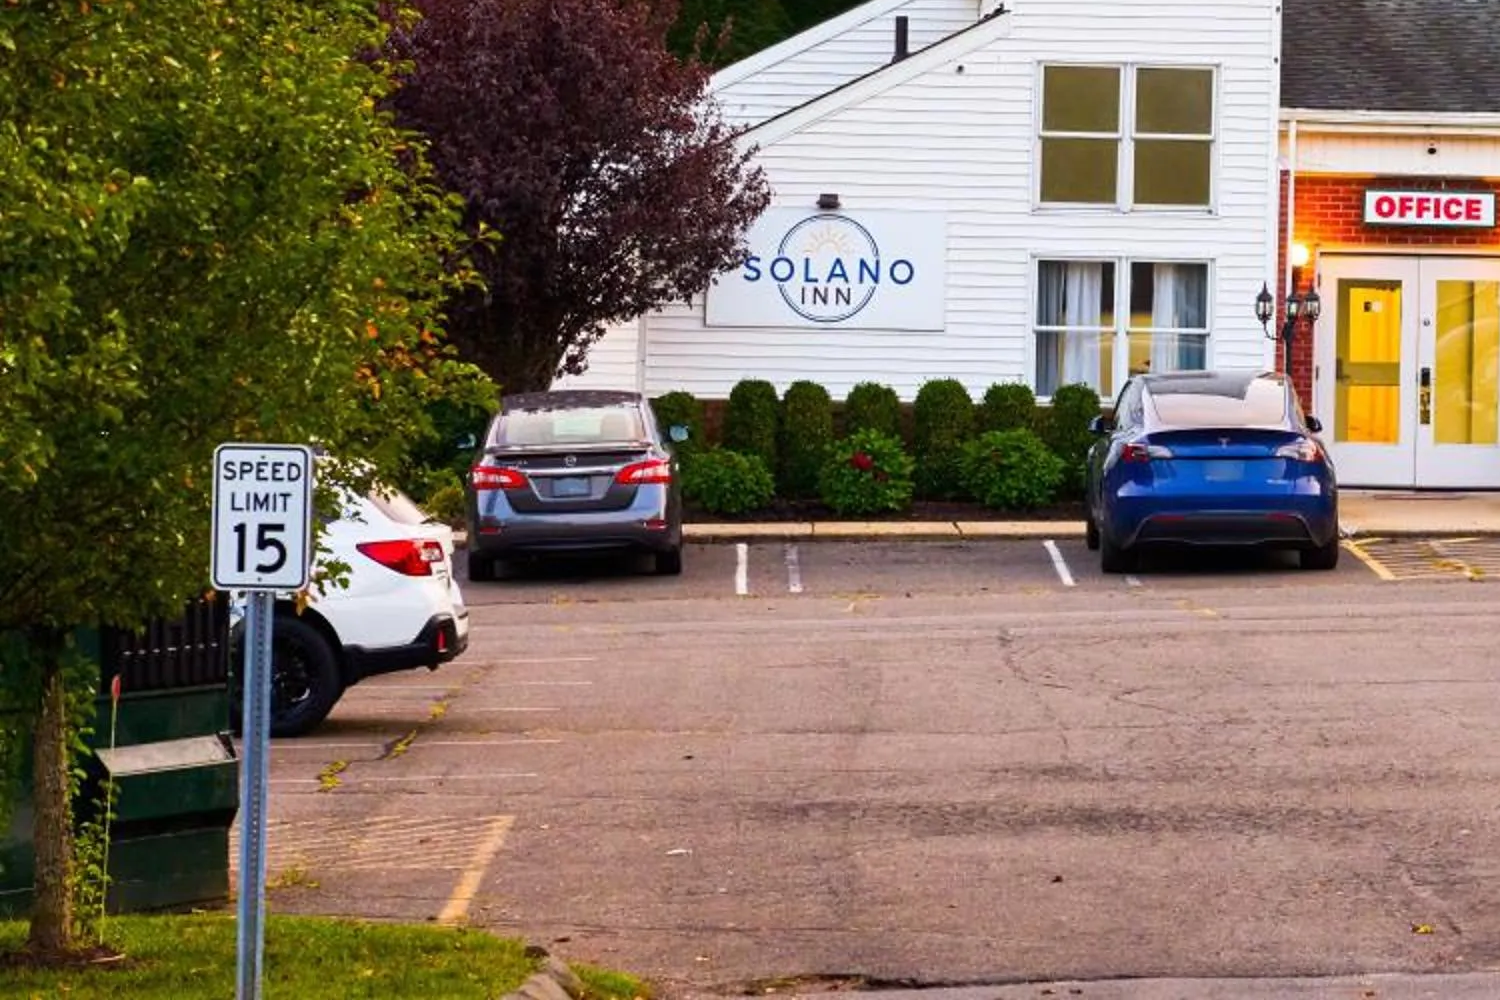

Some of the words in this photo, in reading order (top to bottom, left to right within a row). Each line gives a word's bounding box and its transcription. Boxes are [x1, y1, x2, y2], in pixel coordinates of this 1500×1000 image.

[1374, 195, 1482, 220] OFFICE
[743, 255, 915, 285] SOLANO
[800, 286, 851, 305] INN
[223, 461, 301, 482] SPEED
[230, 491, 292, 513] LIMIT
[233, 522, 288, 575] 15
